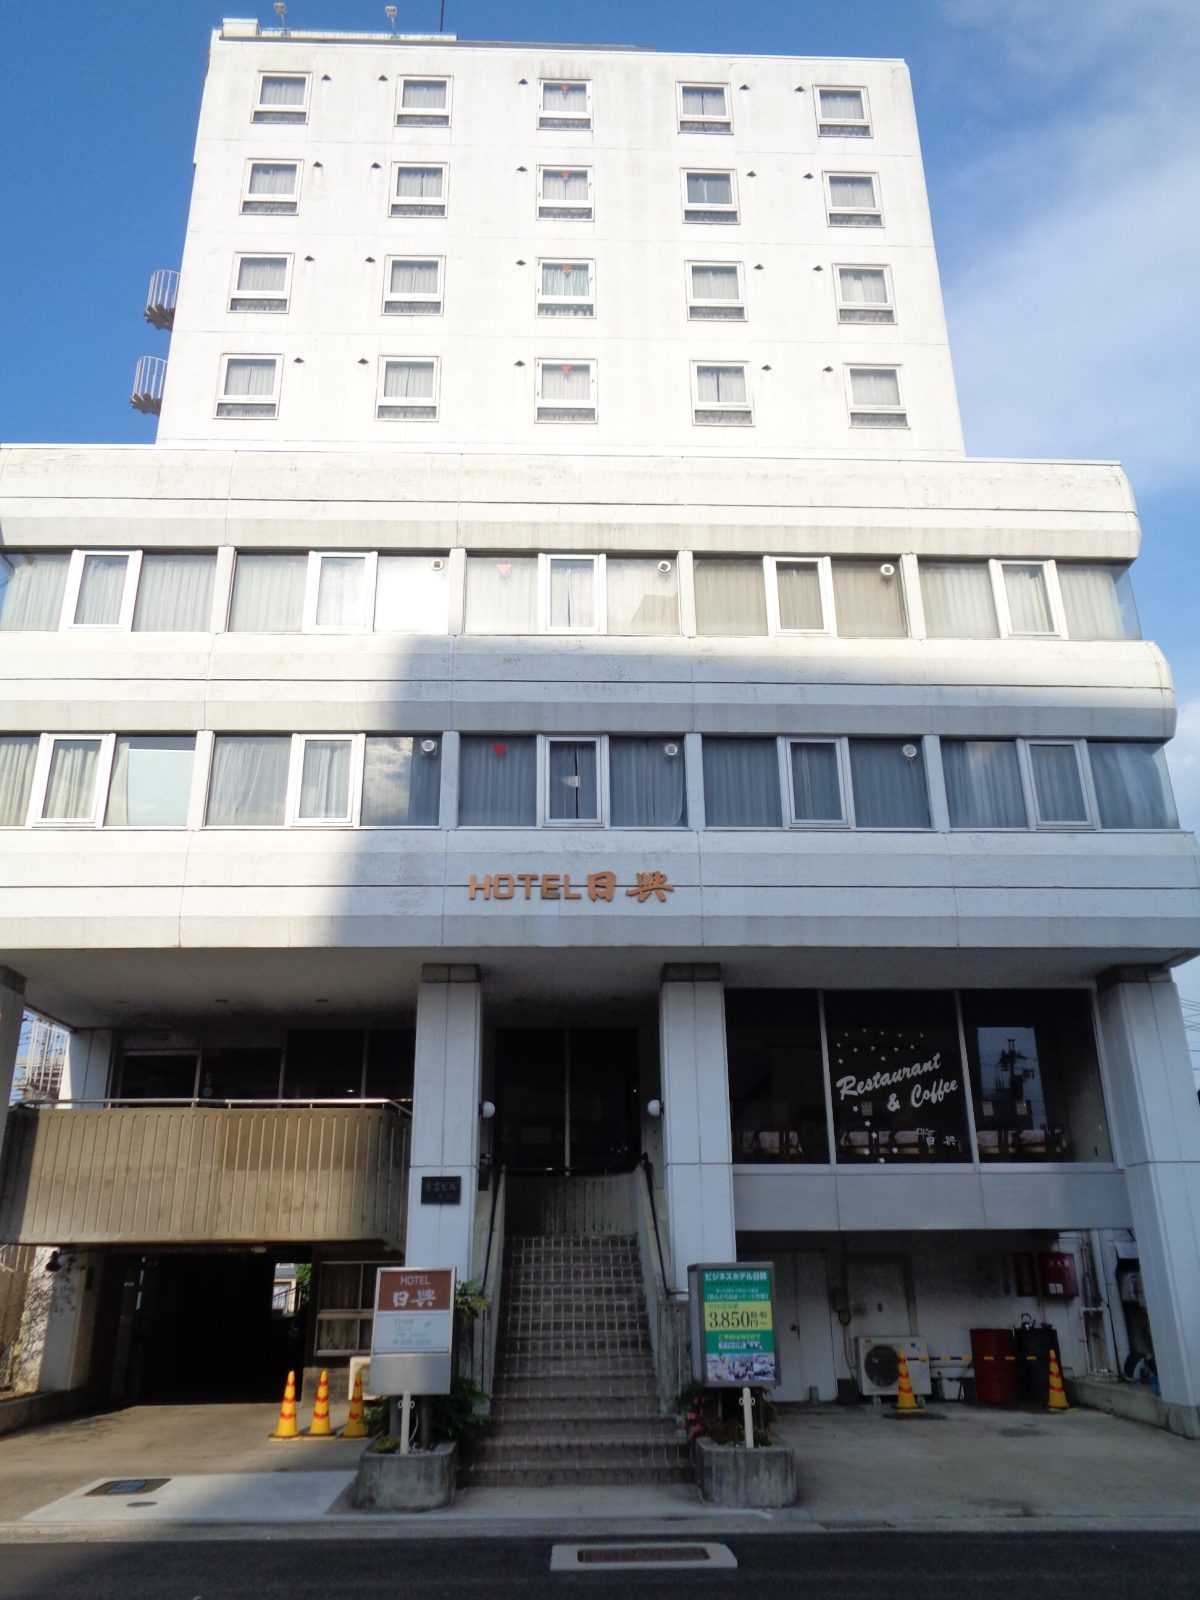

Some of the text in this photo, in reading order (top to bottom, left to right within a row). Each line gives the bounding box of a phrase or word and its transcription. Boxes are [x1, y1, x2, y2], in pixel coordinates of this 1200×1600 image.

[836, 1052, 941, 1100] Restaurant
[887, 1079, 958, 1112] & Coffee
[400, 1275, 431, 1286] HOTEL
